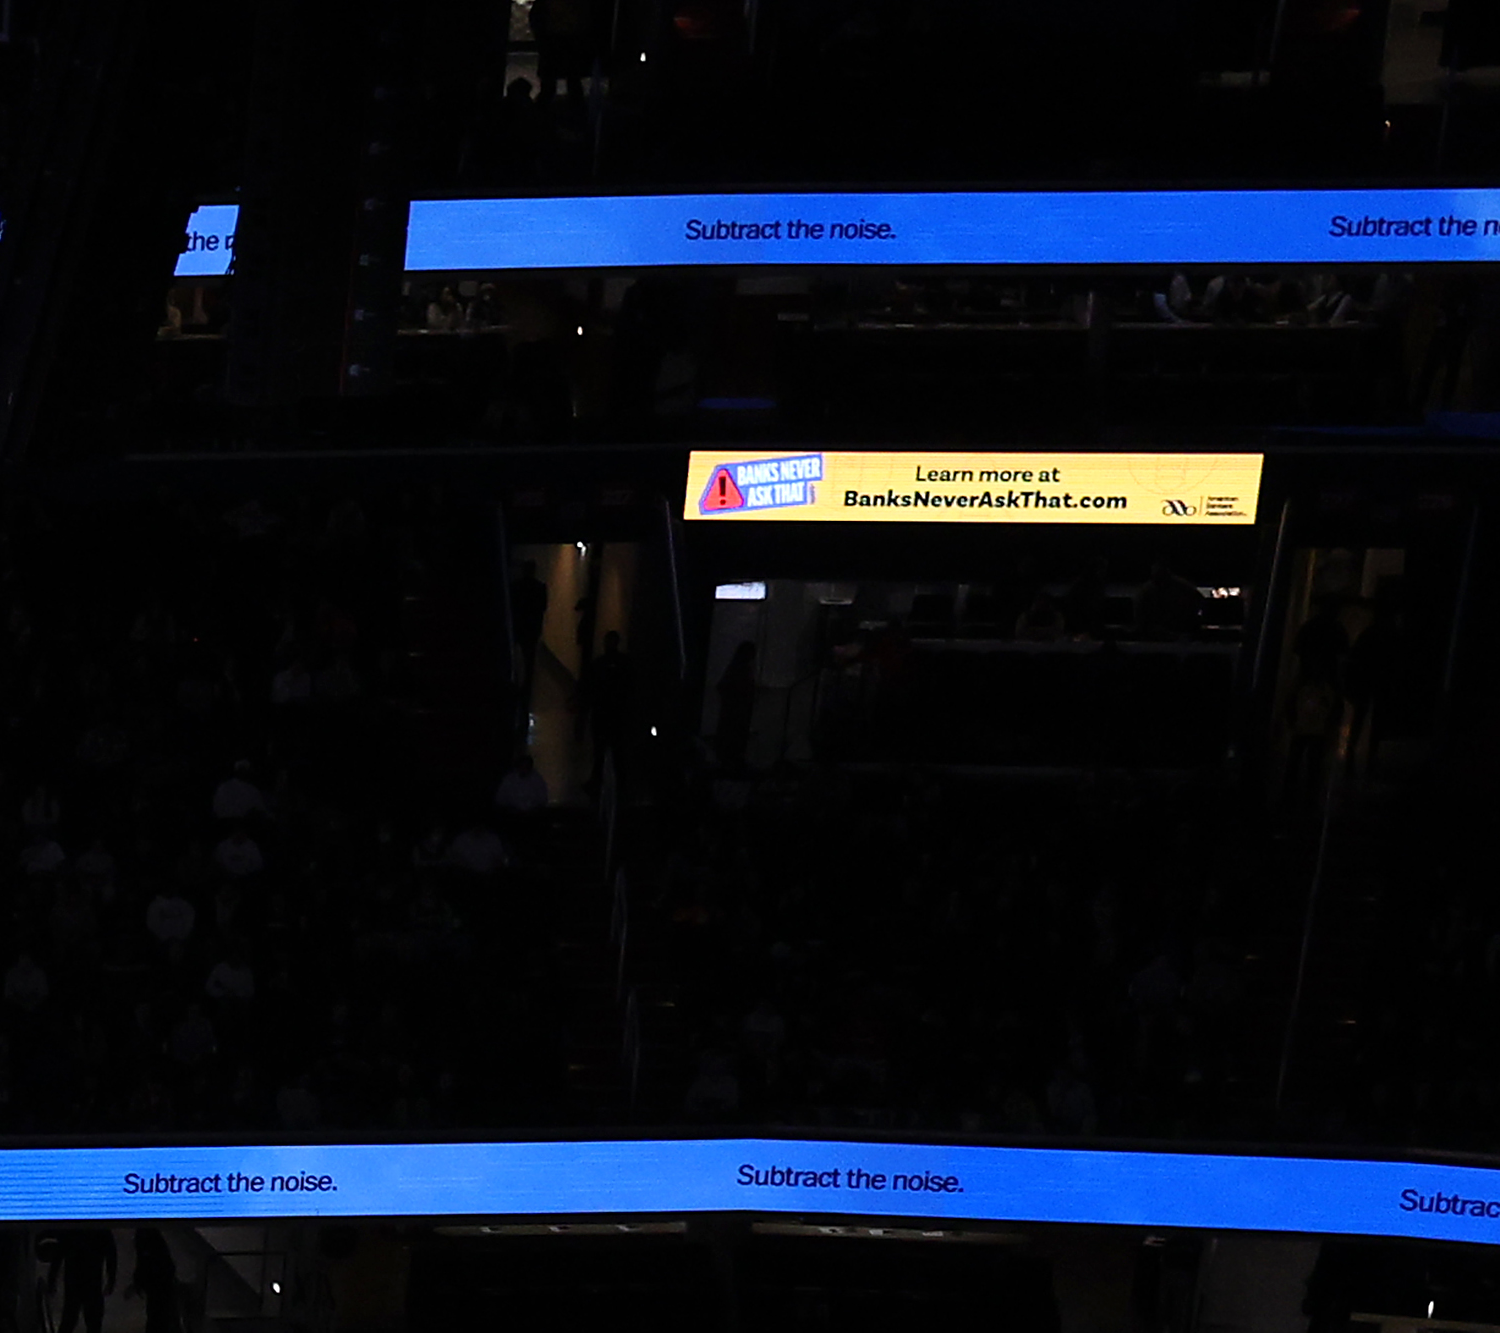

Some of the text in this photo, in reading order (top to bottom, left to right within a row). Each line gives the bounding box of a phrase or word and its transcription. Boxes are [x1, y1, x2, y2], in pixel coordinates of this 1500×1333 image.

[685, 218, 897, 241] Subtract the noise.
[843, 488, 1127, 509] BanksNeverAskThat.com
[736, 1164, 964, 1193] Subtract the noise.
